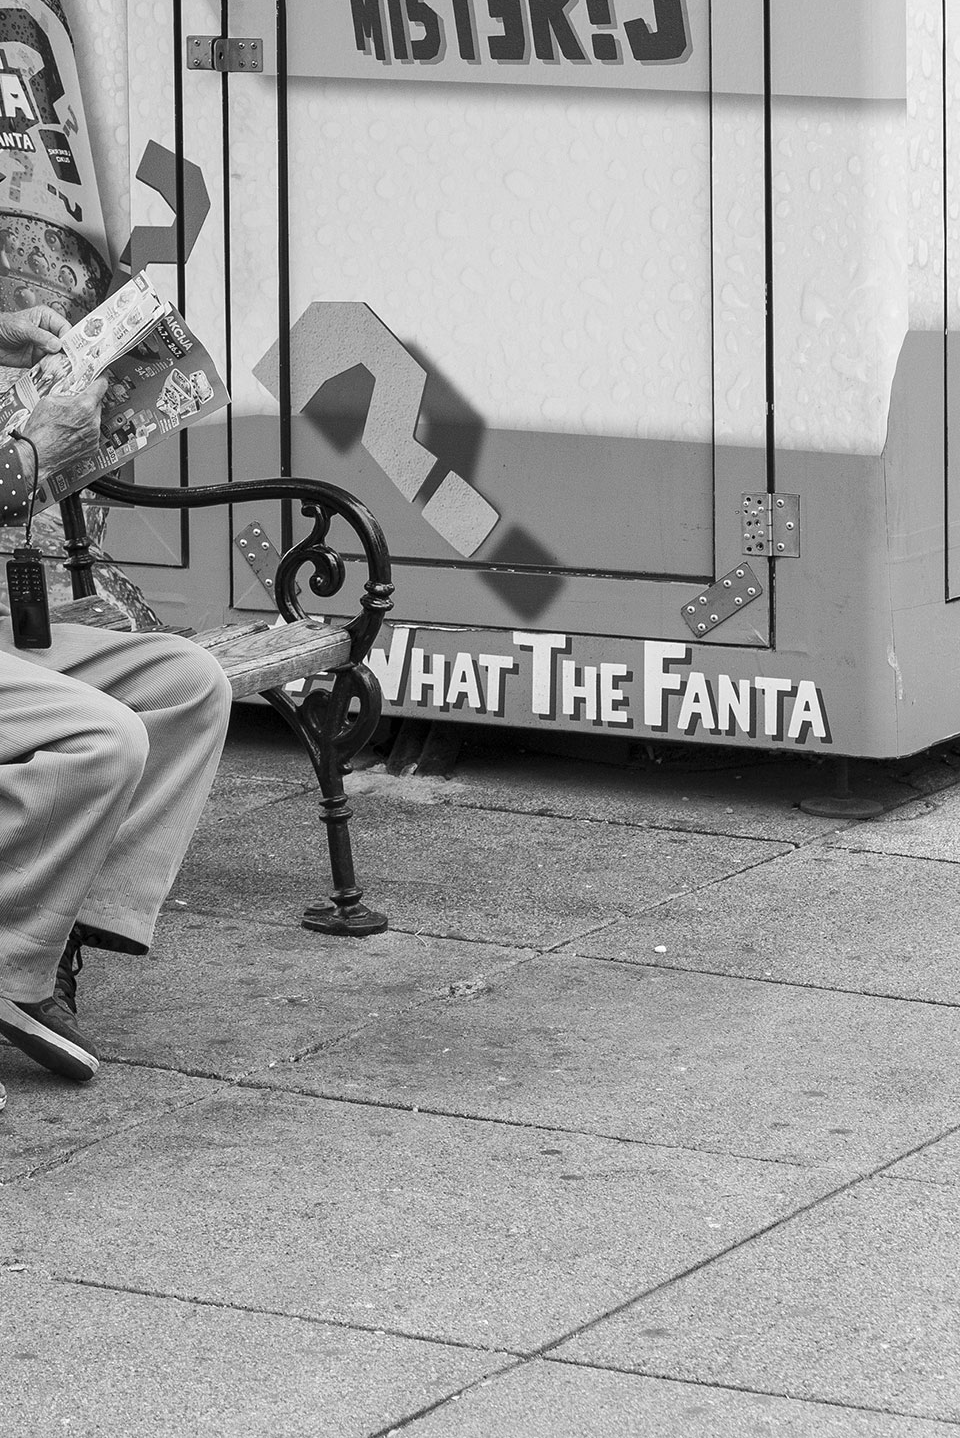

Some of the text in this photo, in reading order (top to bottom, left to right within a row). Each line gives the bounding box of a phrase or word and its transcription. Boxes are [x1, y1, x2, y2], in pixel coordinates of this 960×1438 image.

[165, 315, 193, 351] AKCIJA
[513, 632, 628, 723] THE
[644, 640, 827, 738] FANTA
